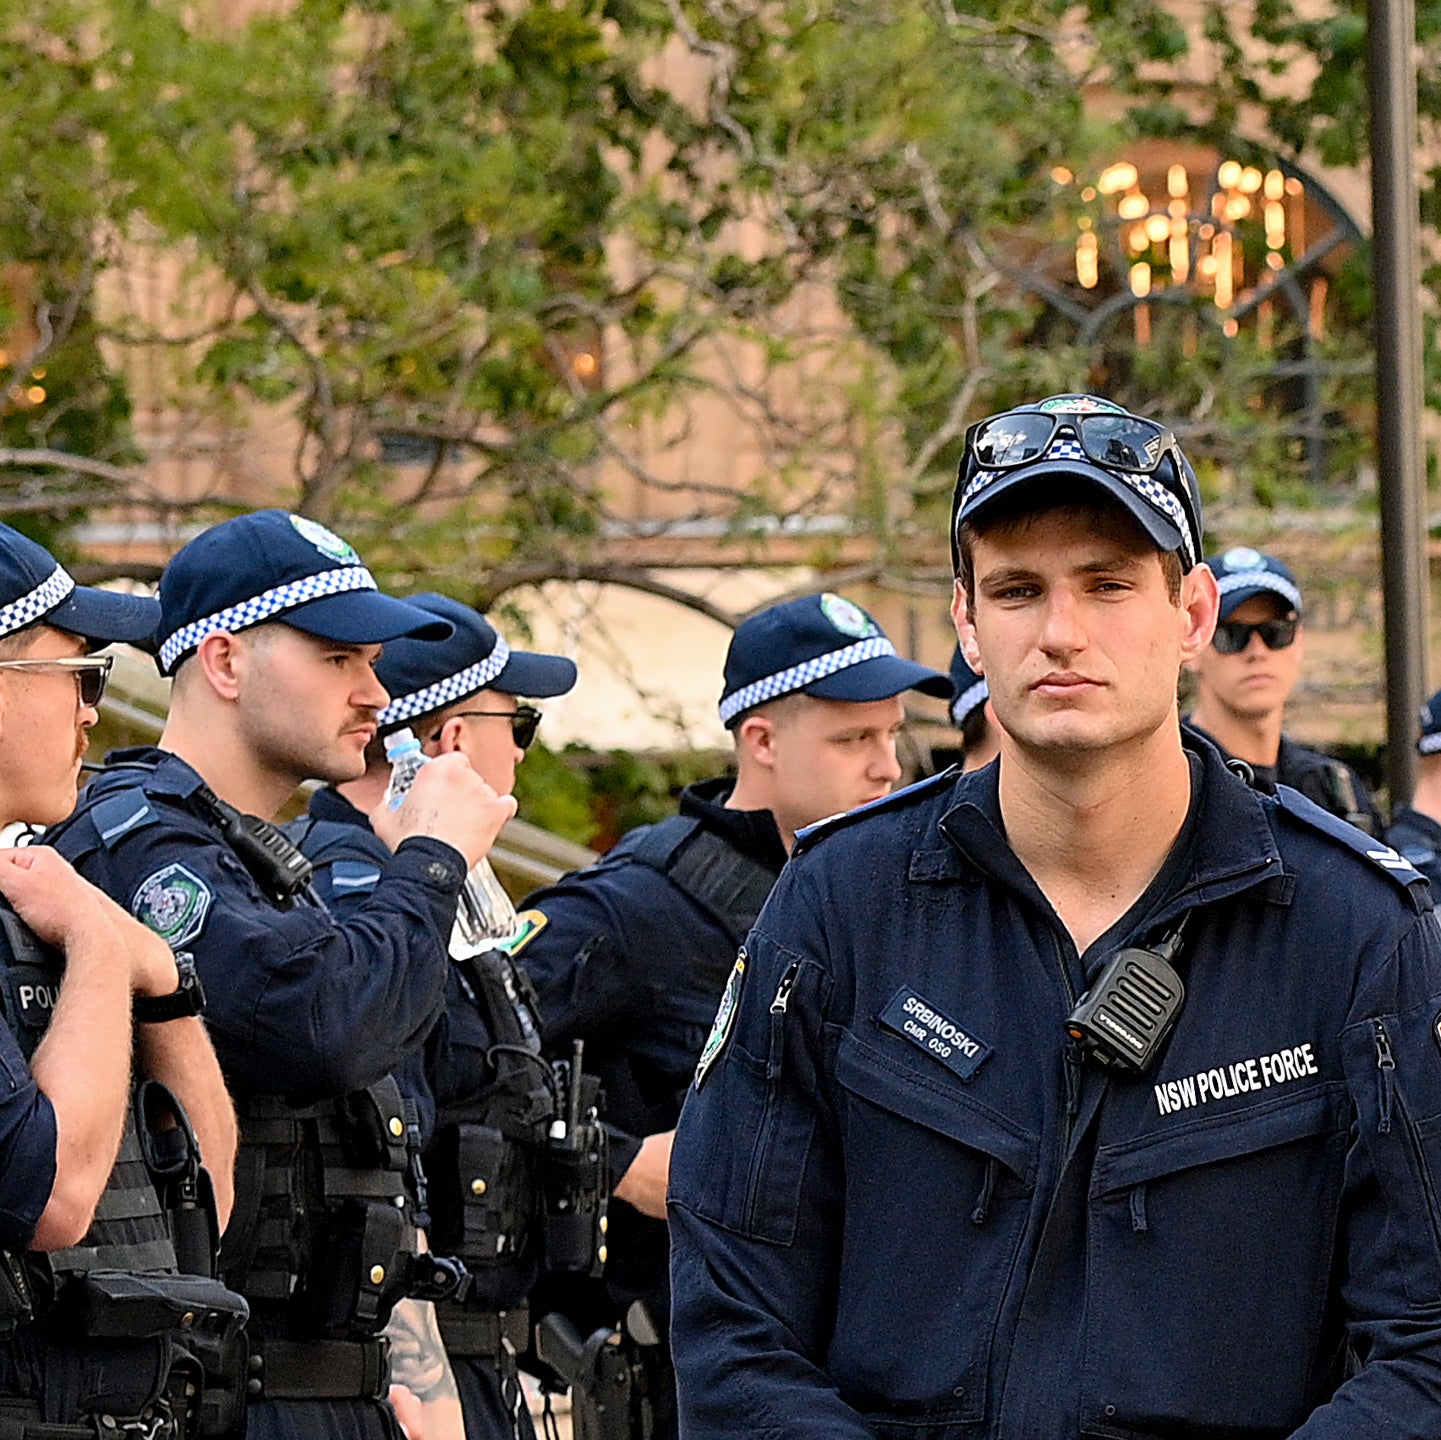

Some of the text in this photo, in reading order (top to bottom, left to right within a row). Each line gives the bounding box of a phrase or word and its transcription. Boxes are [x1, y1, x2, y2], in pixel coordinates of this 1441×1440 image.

[903, 997, 979, 1058] SRBINOSKI
[903, 1020, 952, 1058] CMR OSG
[1154, 1043, 1319, 1116] NSW POLICE FORCE
